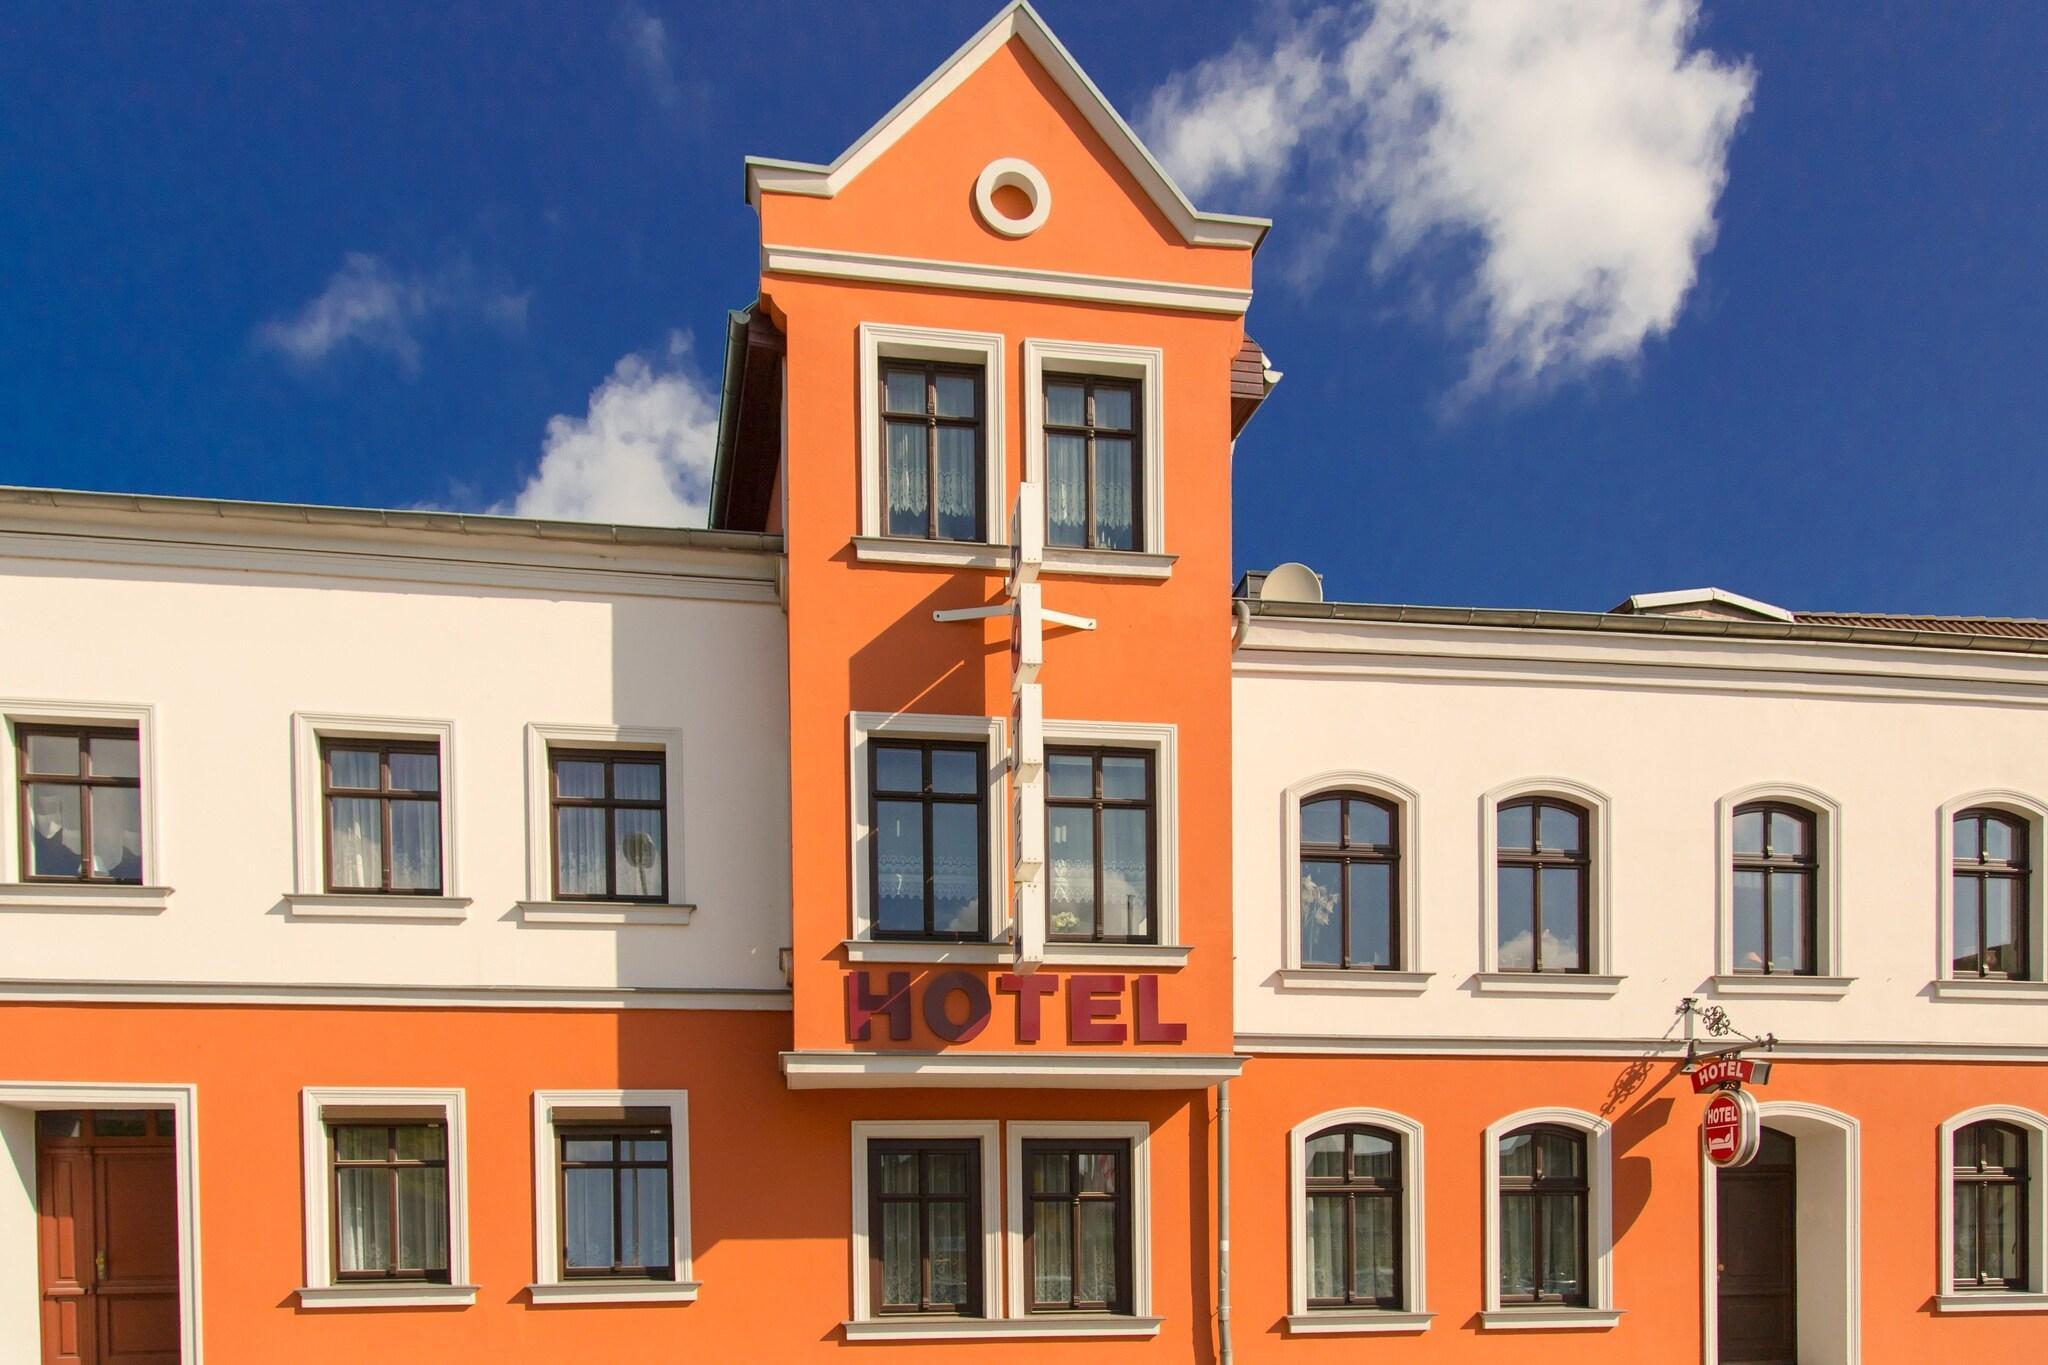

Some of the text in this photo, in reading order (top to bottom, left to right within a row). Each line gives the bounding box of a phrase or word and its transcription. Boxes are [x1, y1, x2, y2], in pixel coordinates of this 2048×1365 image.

[849, 971, 1187, 1042] HOTEL
[1699, 1061, 1743, 1086] HOTEL
[1707, 1106, 1737, 1124] HOTEL
